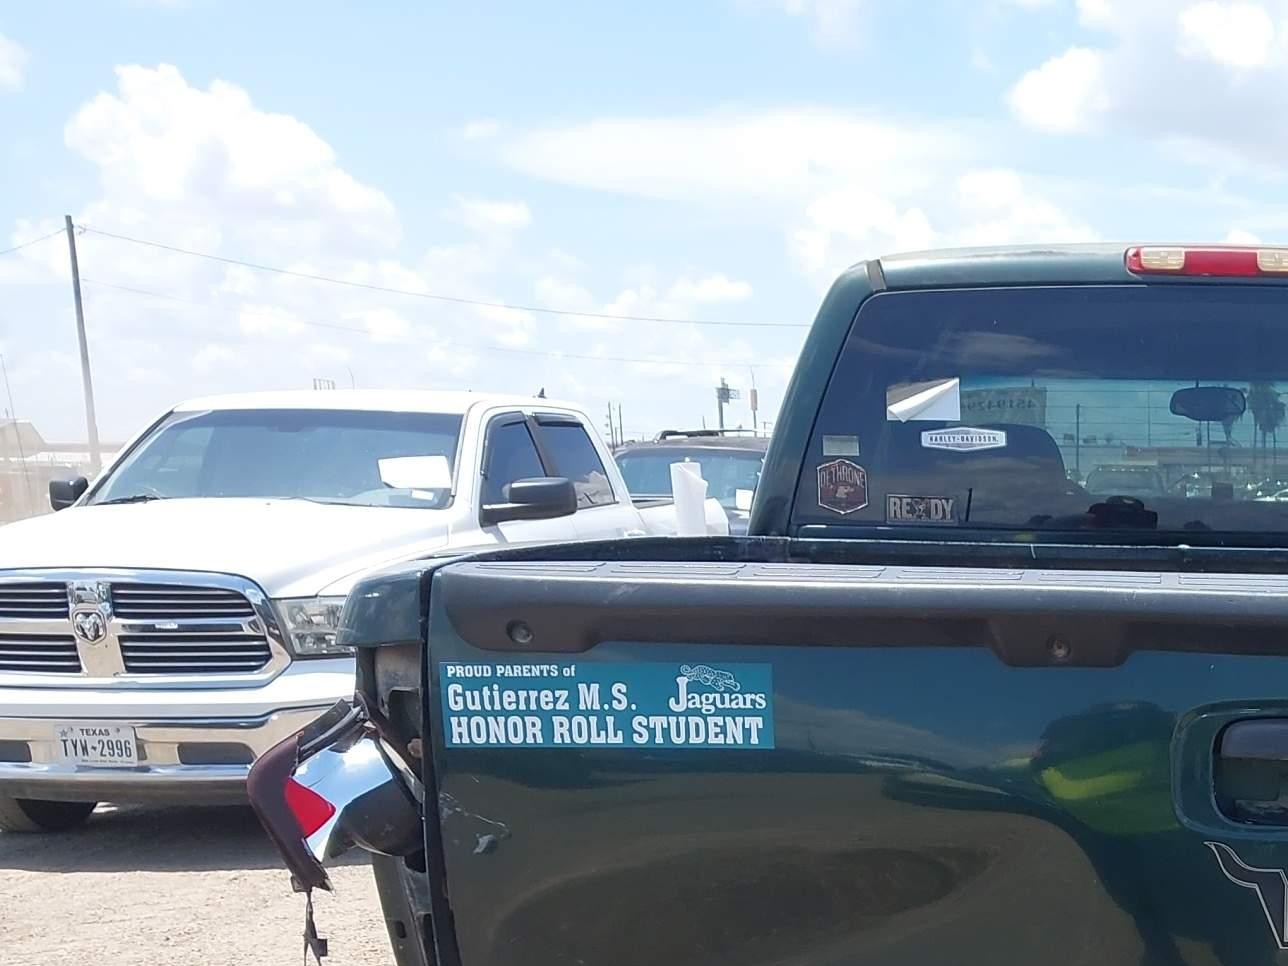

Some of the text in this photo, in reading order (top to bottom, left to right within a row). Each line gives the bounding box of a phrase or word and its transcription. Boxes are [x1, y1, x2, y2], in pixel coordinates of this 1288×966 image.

[447, 665, 576, 677] PROUD PARENTS of
[448, 683, 637, 711] Gutierrez M.S.
[669, 677, 767, 714] Jaguars
[80, 728, 110, 736] TEXAS
[451, 716, 763, 744] HONOR ROLL STUDENT
